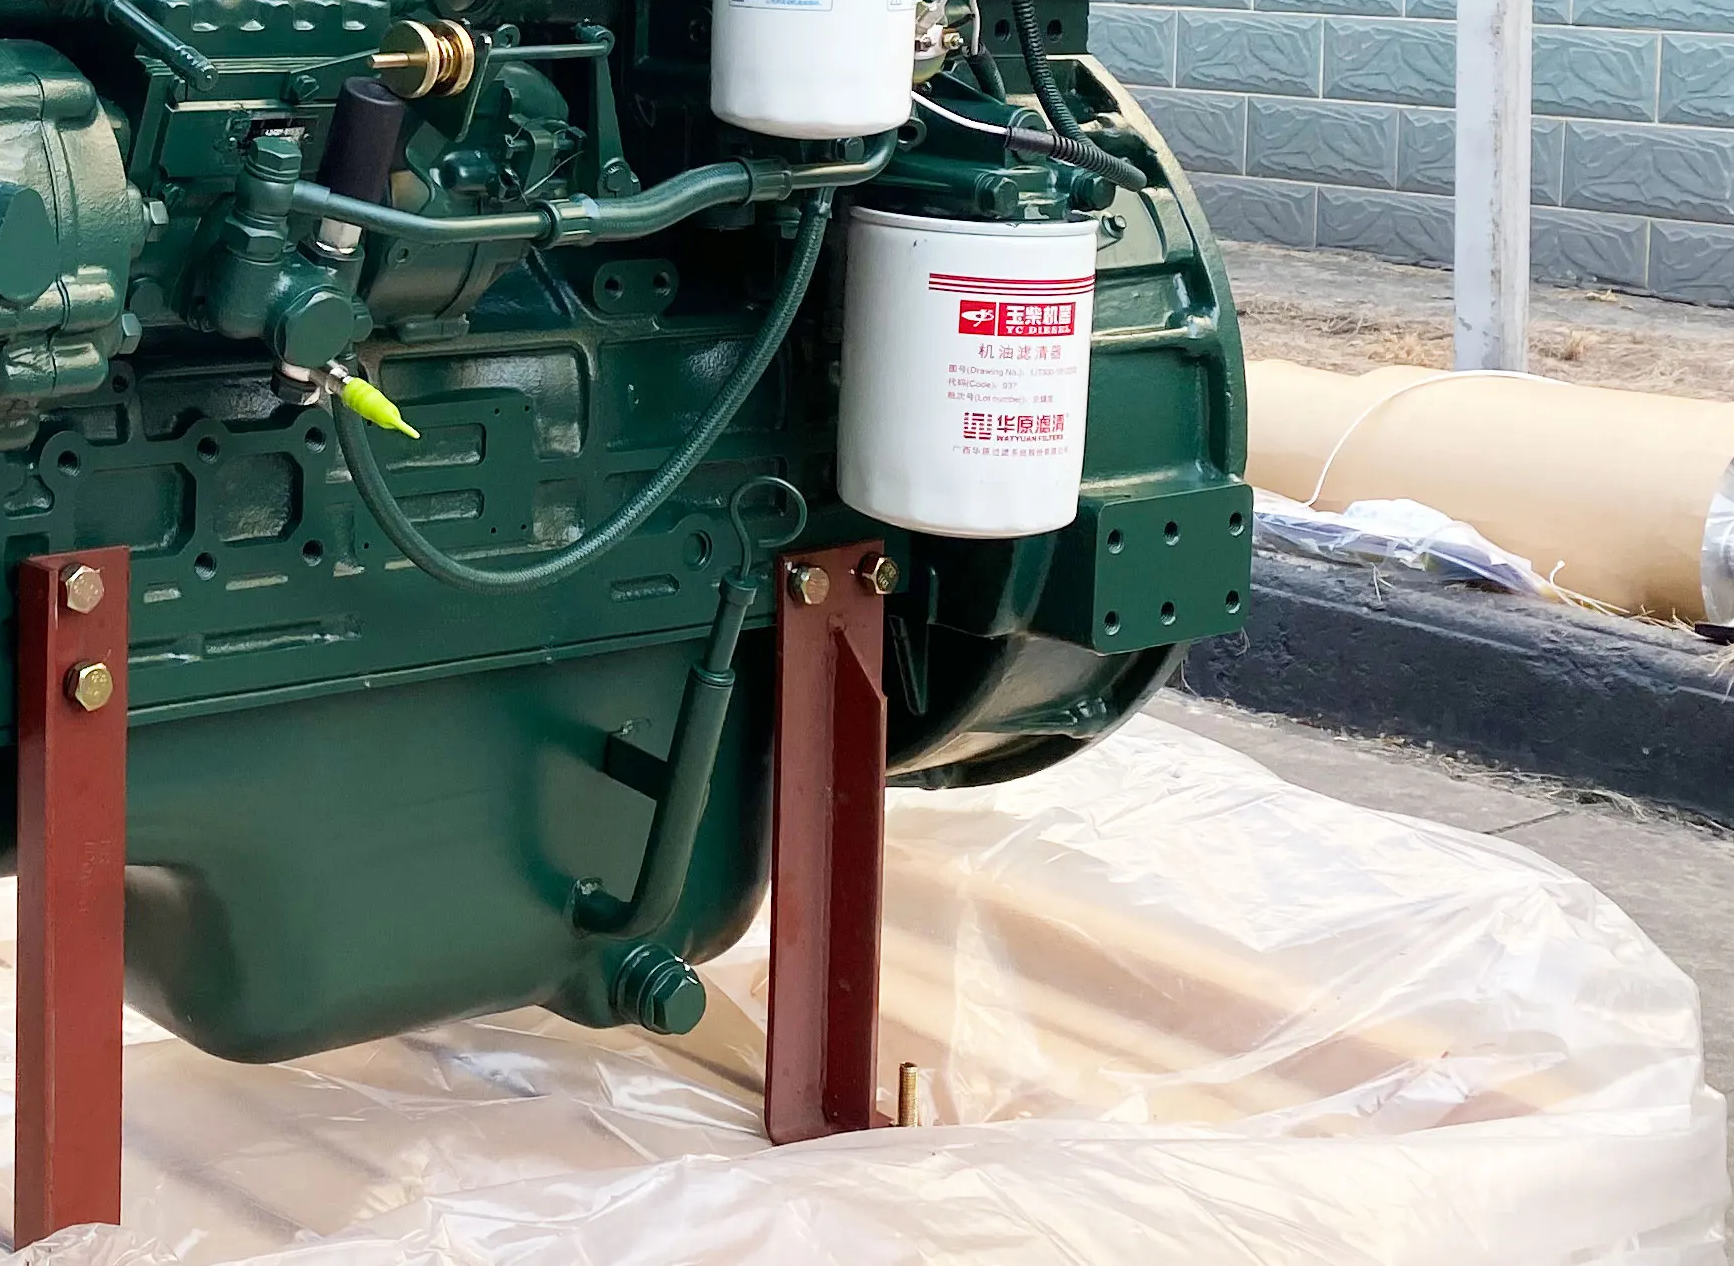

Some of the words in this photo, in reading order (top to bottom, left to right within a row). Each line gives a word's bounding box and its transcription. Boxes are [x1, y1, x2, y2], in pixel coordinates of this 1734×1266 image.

[1006, 305, 1072, 326] 玉柴机器
[1006, 325, 1024, 334] YC
[1028, 325, 1072, 334] DIESEL
[978, 342, 1062, 361] 机油滤清器
[996, 414, 1066, 434] 华原滤清
[1038, 434, 1065, 442] FILTERS
